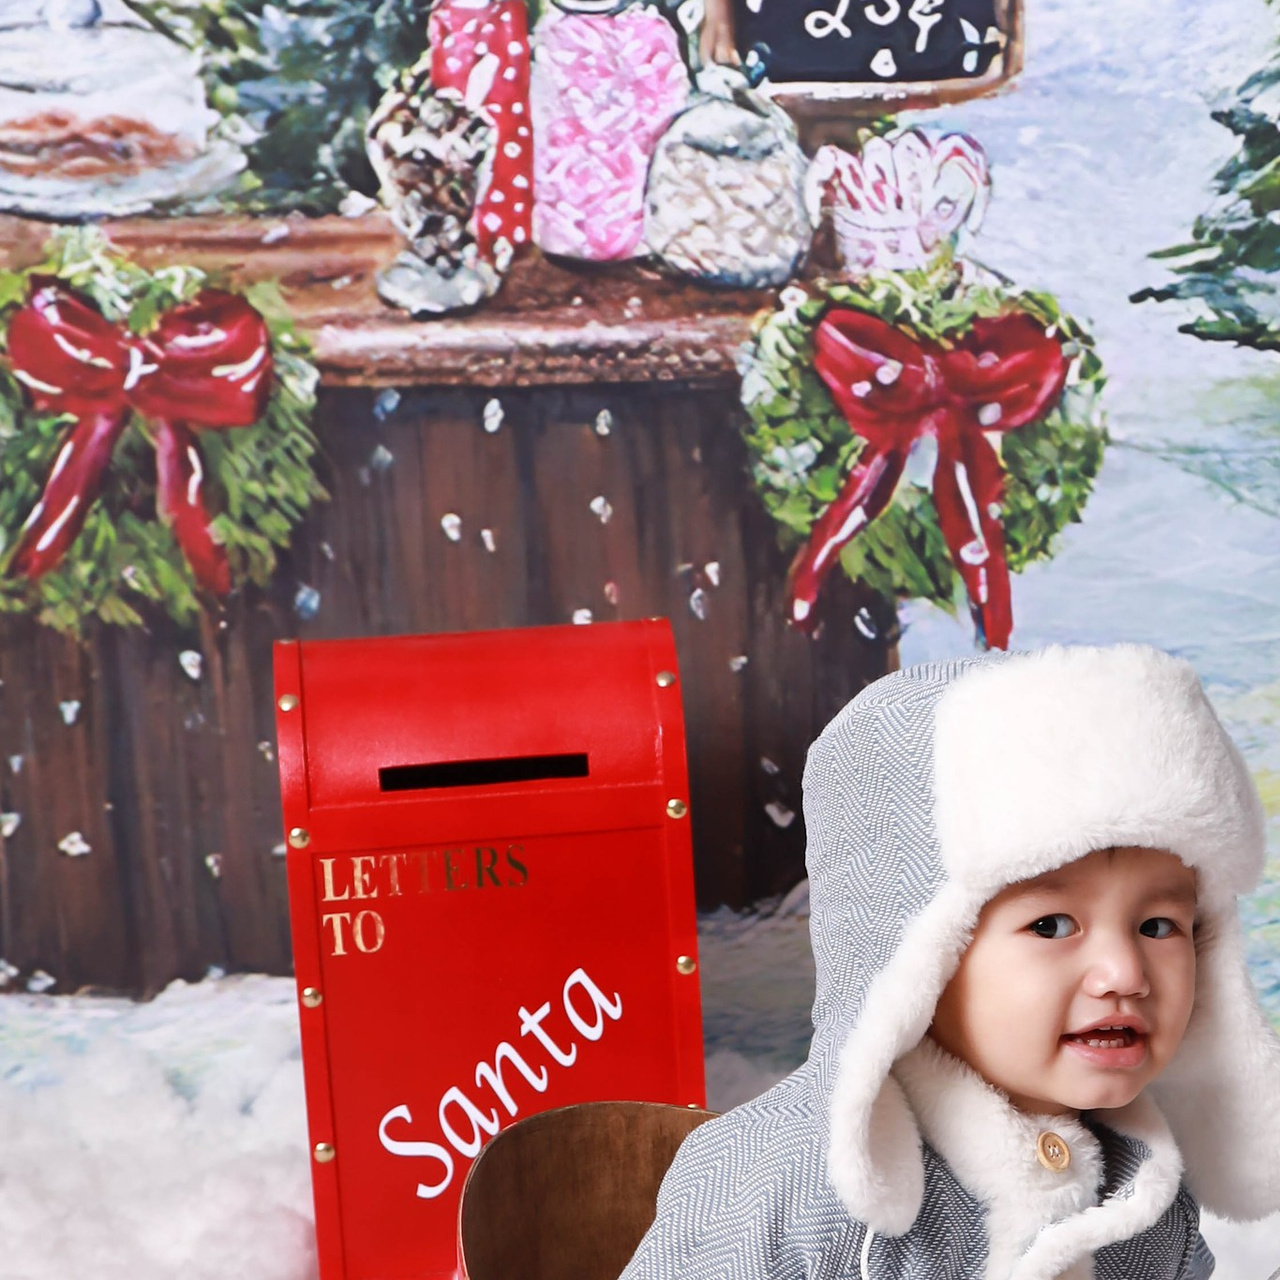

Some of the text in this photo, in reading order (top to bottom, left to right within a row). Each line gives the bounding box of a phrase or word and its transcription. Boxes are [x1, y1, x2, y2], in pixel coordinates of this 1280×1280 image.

[318, 843, 530, 902] LETTERS
[322, 909, 386, 957] TO
[378, 967, 623, 1199] Santa
